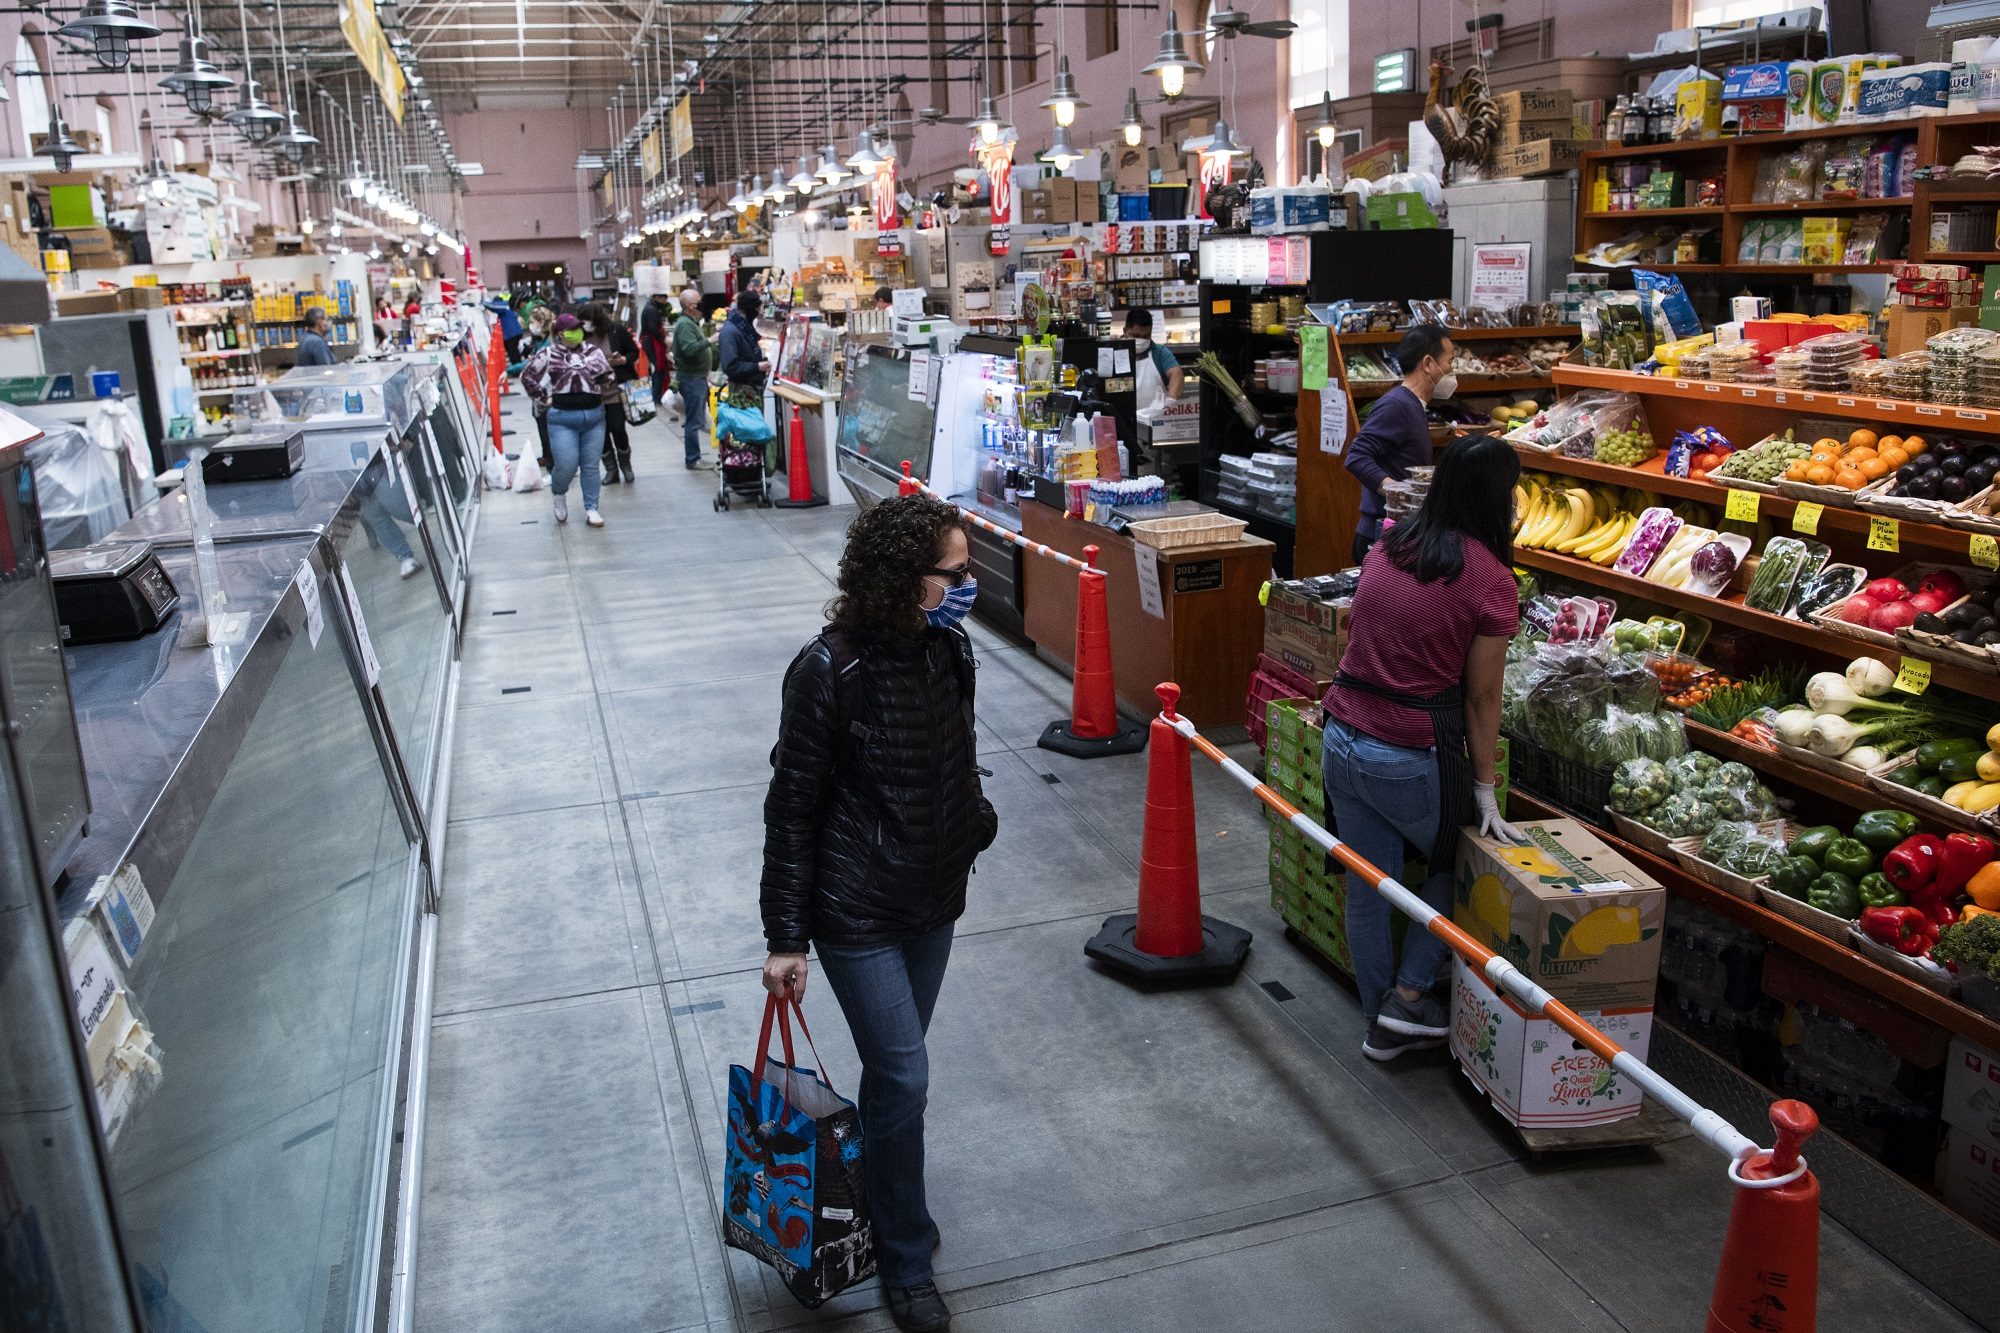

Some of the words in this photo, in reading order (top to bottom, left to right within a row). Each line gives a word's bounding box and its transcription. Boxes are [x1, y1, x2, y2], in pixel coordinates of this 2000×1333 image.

[1951, 73, 1975, 88] wel
[1979, 72, 1997, 80] LEACH
[1865, 79, 1894, 97] Soft
[1522, 98, 1556, 109] T-Shirt
[1866, 88, 1904, 107] STRONG
[1552, 149, 1585, 160] T-Shir
[1872, 518, 1891, 527] Black
[1877, 526, 1895, 535] Plum
[1176, 565, 1197, 576] 2019
[1901, 664, 1930, 679] Avocado
[81, 977, 116, 1036] Empanada
[1551, 1055, 1606, 1075] FRESH
[1569, 1073, 1597, 1087] Quality
[1549, 1082, 1593, 1106] Limes
